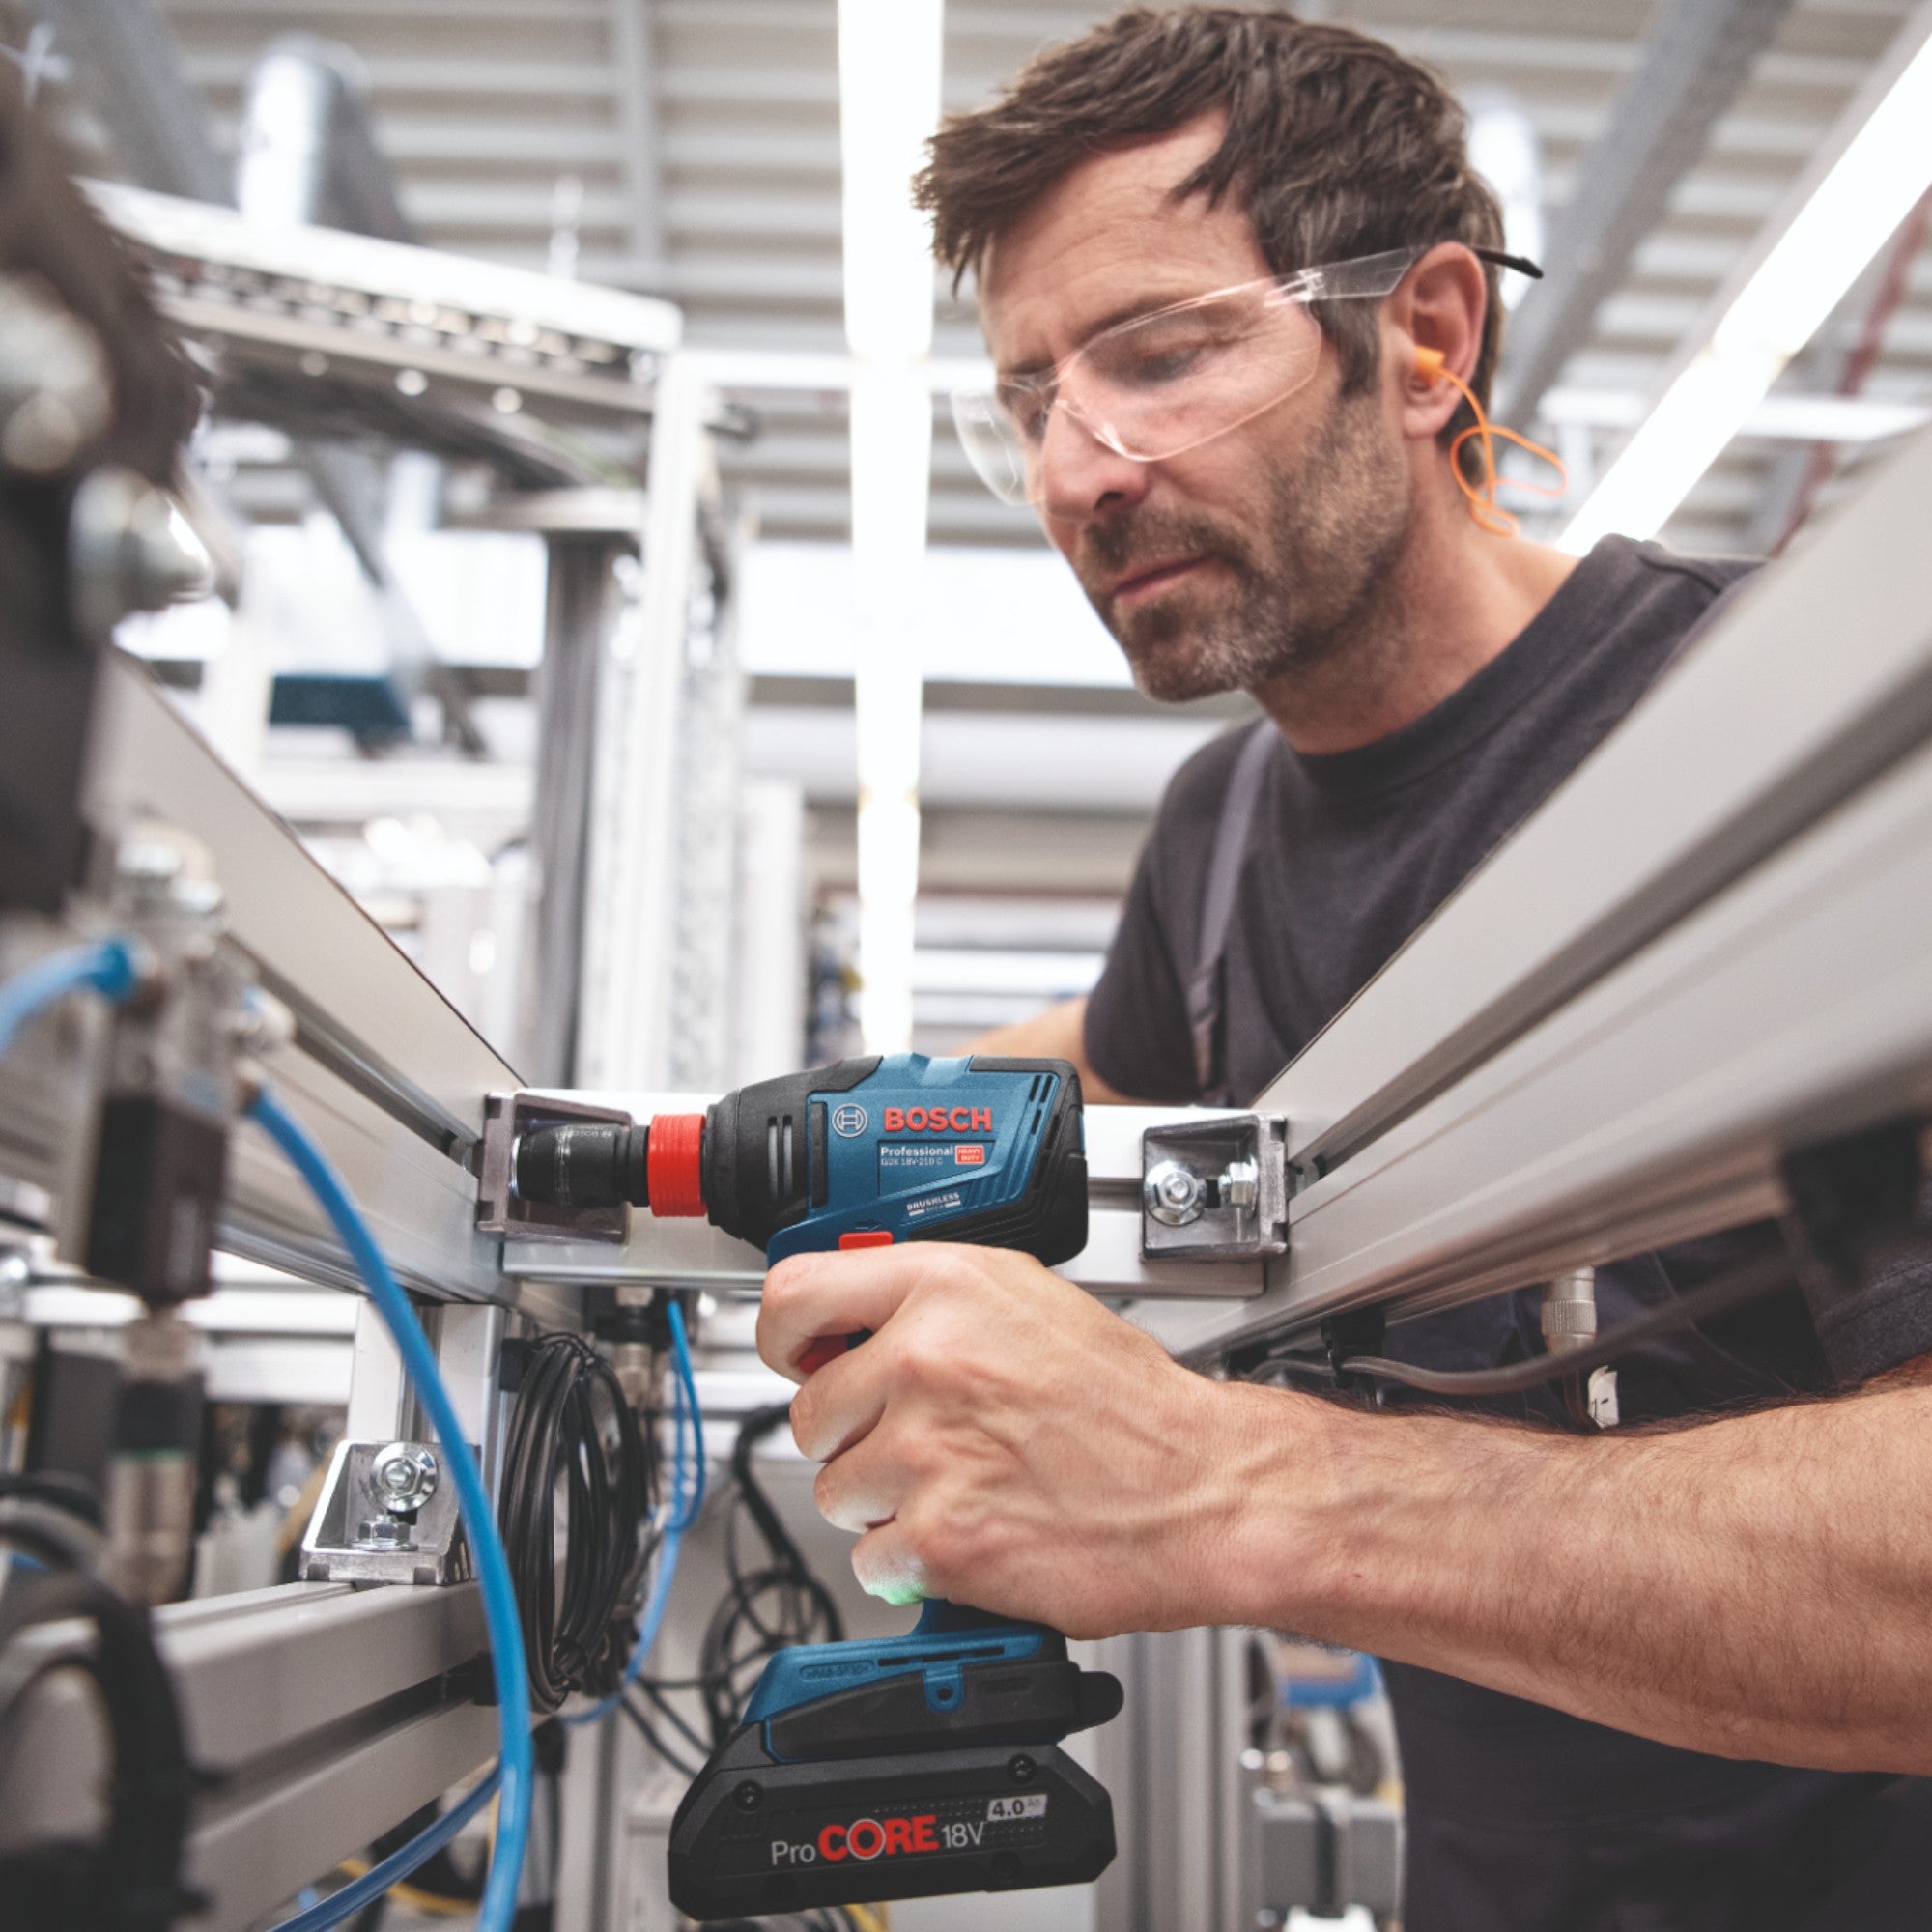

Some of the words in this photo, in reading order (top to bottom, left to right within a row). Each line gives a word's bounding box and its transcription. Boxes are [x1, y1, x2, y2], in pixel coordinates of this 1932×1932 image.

[883, 1106, 993, 1132] BOSCH
[880, 1146, 953, 1156] Professional
[906, 1192, 960, 1211] BRUSHLESS
[992, 1798, 1025, 1817] 4.0
[942, 1821, 985, 1849] 18V
